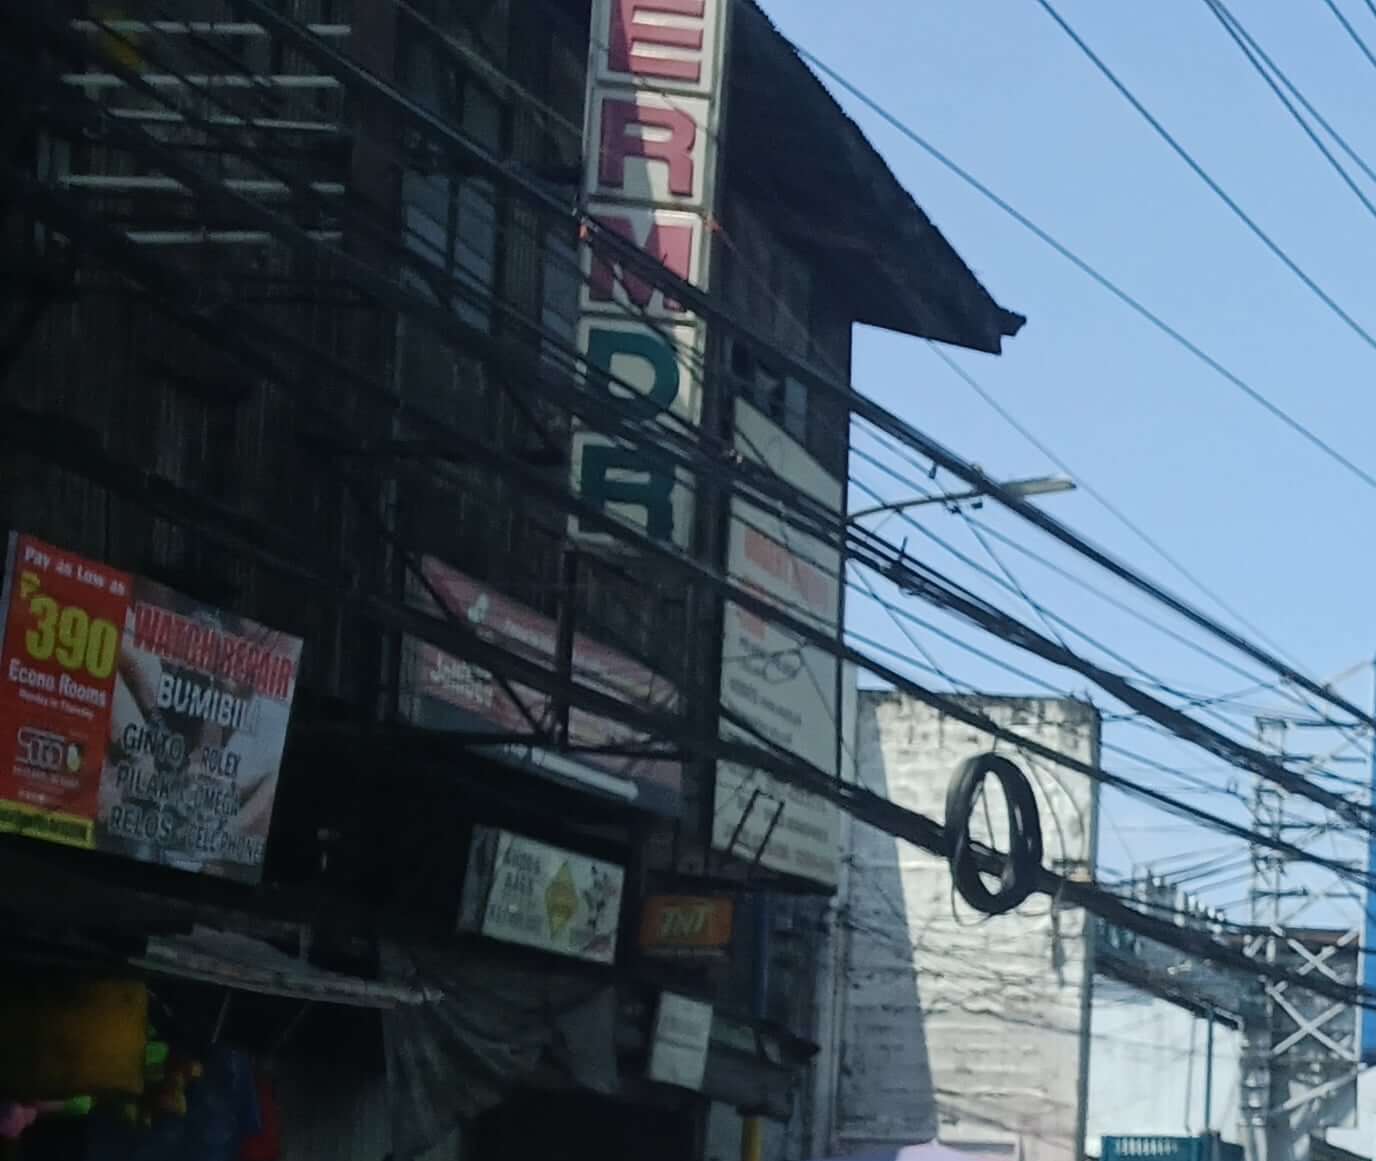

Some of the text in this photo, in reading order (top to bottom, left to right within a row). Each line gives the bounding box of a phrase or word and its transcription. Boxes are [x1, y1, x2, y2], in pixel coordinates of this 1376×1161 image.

[24, 545, 50, 572] Pay
[77, 564, 105, 589] Low
[9, 657, 108, 710] Econo Rooms
